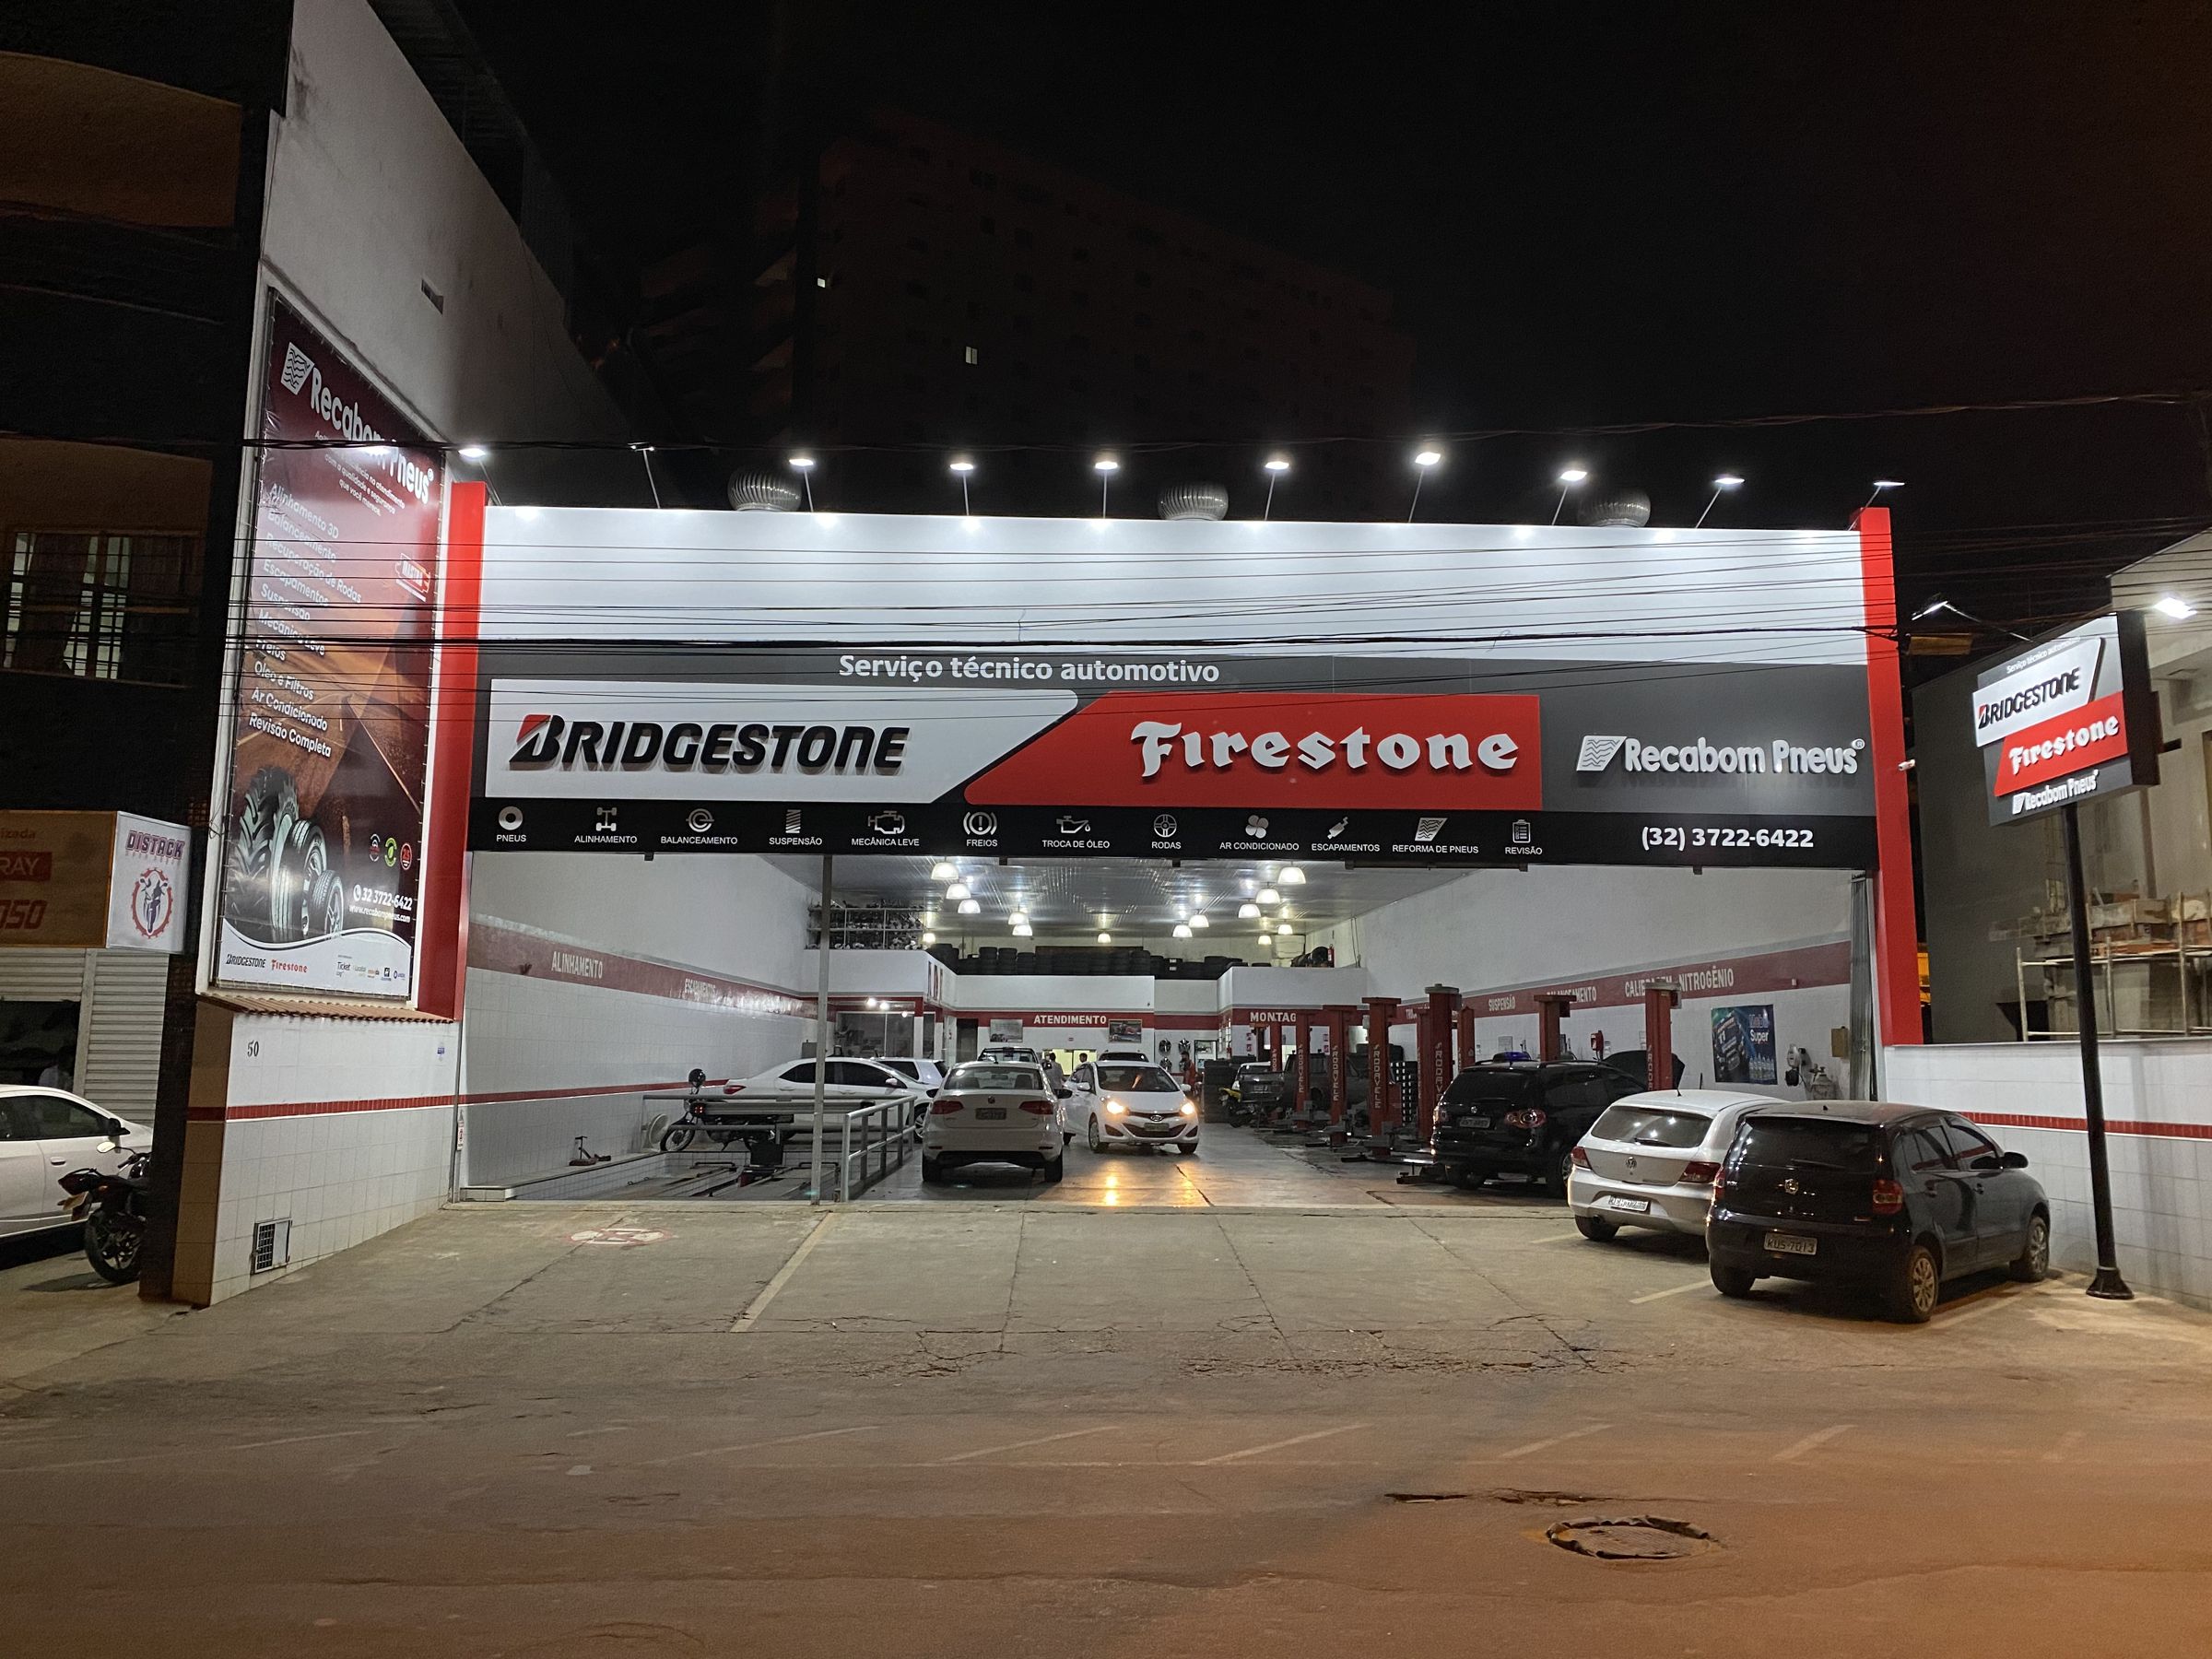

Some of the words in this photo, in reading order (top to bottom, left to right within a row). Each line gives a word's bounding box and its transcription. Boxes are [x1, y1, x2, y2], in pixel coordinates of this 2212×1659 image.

[270, 483, 326, 532] Alinhamento
[327, 524, 339, 539] 3D
[325, 572, 336, 588] de
[336, 578, 361, 604] Rodas
[840, 655, 942, 684] Serviço
[950, 655, 1053, 681] técnico
[1060, 658, 1219, 682] automotivo
[285, 676, 314, 700] Filtros
[1978, 666, 2080, 729] BRIDGESTONE
[252, 687, 265, 701] Ar
[265, 693, 328, 732] Condicionado
[249, 712, 288, 739] Revisão
[288, 729, 332, 758] Completa
[509, 714, 911, 772] BRIDGESTONE
[1131, 721, 1520, 778] Firestone
[2008, 715, 2120, 775] Firestone
[1624, 737, 1766, 773] Recabom
[125, 830, 185, 860] DISTACK
[496, 834, 527, 843] PNEUS
[574, 835, 638, 844] ALINHAMENTO
[661, 836, 738, 845] BALANCEAMENTO
[769, 836, 823, 846] SUSPENSÃO
[852, 837, 897, 847] MECÂNICA
[898, 838, 920, 847] LEVE
[966, 839, 998, 848] FREIOS
[1041, 840, 1074, 849] TROCA
[1074, 840, 1086, 849] DE
[1086, 839, 1111, 849] ÓLEO
[1151, 841, 1182, 850] RODAS
[1219, 841, 1233, 851] AR
[1233, 841, 1300, 851] CONDICIONADO
[1641, 827, 1687, 852] (32)
[1692, 829, 1814, 849] 3722-6422
[1311, 843, 1381, 853] ESCAPAMENTOS
[1392, 844, 1435, 853] REFORMA
[1436, 845, 1449, 853] DE
[1450, 845, 1479, 854] PNEUS
[1505, 846, 1543, 855] REVISÃO
[361, 888, 372, 902] 32
[372, 889, 413, 911] 3722-6422
[226, 954, 266, 969] BRIDGESTONE
[271, 959, 308, 973] Firestone
[551, 951, 604, 979] ALINHAMENTO
[1678, 966, 1735, 992] NITROGÊNIO
[1488, 994, 1516, 1012] SUSPENSÃO
[1033, 1015, 1107, 1025] ATENDIMENTO
[1250, 1012, 1297, 1022] MONTAG
[247, 1041, 259, 1057] 50
